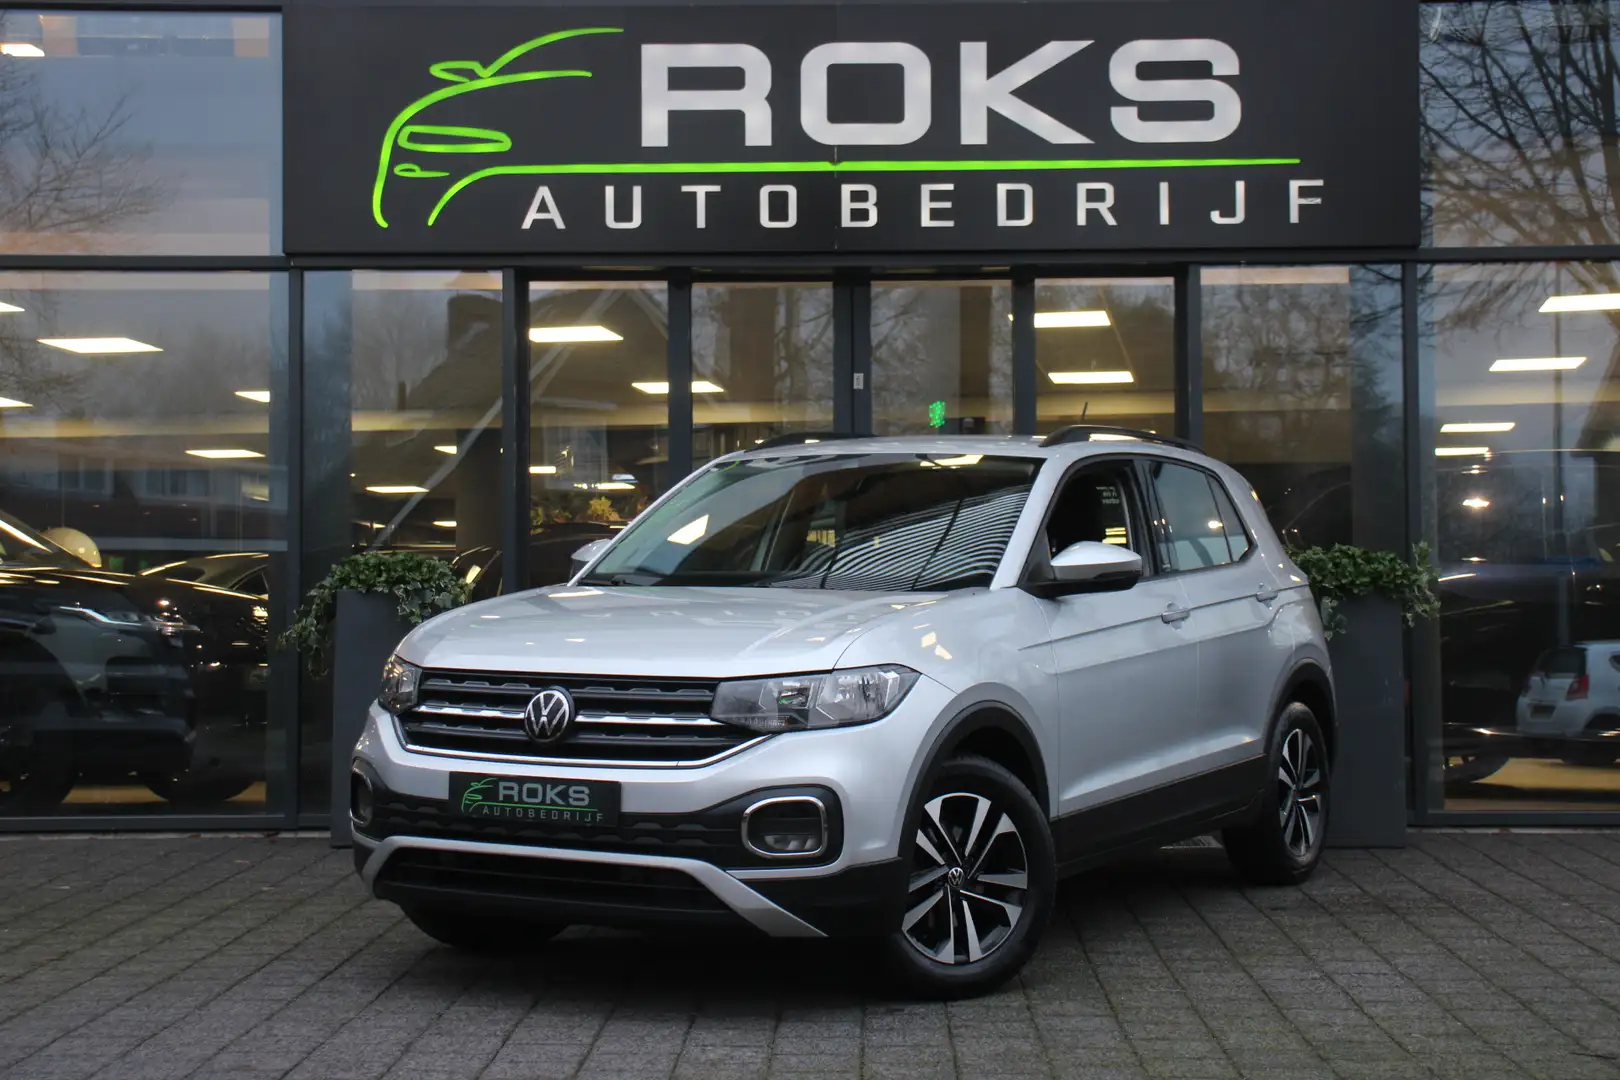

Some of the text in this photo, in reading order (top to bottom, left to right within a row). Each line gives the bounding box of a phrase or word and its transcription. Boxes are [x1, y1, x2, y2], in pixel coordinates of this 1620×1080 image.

[640, 38, 1242, 148] ROKS
[521, 180, 1325, 230] AUTOBEDRIJF
[498, 781, 590, 806] ROKS
[482, 805, 604, 823] AUTOBEDRIJF
